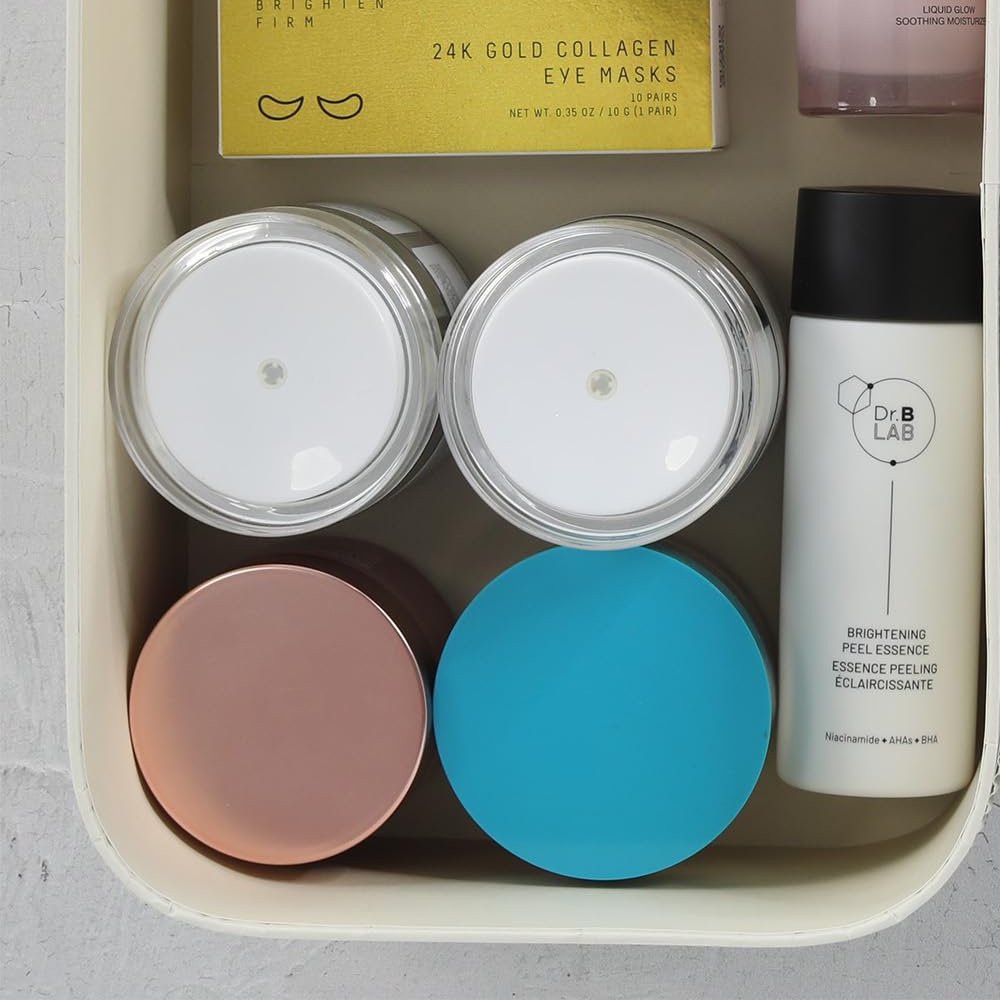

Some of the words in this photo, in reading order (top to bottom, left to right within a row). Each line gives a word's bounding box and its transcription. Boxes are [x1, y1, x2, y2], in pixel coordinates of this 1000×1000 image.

[923, 6, 952, 14] LIQUID
[954, 6, 975, 14] GLOW
[257, 16, 313, 28] FIRM
[896, 17, 945, 25] SOOTHING
[433, 43, 472, 59] 24K
[487, 42, 542, 58] GOLD
[557, 40, 674, 57] COLLAGEN
[545, 67, 585, 84] EYE
[601, 66, 675, 83] MASKS
[631, 93, 642, 102] 10
[647, 93, 678, 102] PAIRS
[510, 108, 529, 117] NET
[556, 108, 577, 117] 0.35
[582, 107, 595, 116] OZ
[608, 107, 619, 116] 10
[623, 107, 630, 116] G
[633, 106, 643, 116] (1
[648, 106, 678, 116] PAIR)
[873, 422, 914, 441] LAB
[847, 627, 927, 640] BRIGHTENING
[842, 642, 873, 655] PEEL
[875, 644, 930, 656] ESSENCE
[832, 660, 887, 674] ESSENCE
[889, 663, 938, 675] PEELING
[835, 675, 934, 690] ÉCLAIRCISSANTE
[825, 731, 880, 745] Niacinamide
[889, 736, 913, 745] AHAs
[921, 735, 939, 745] BHA
